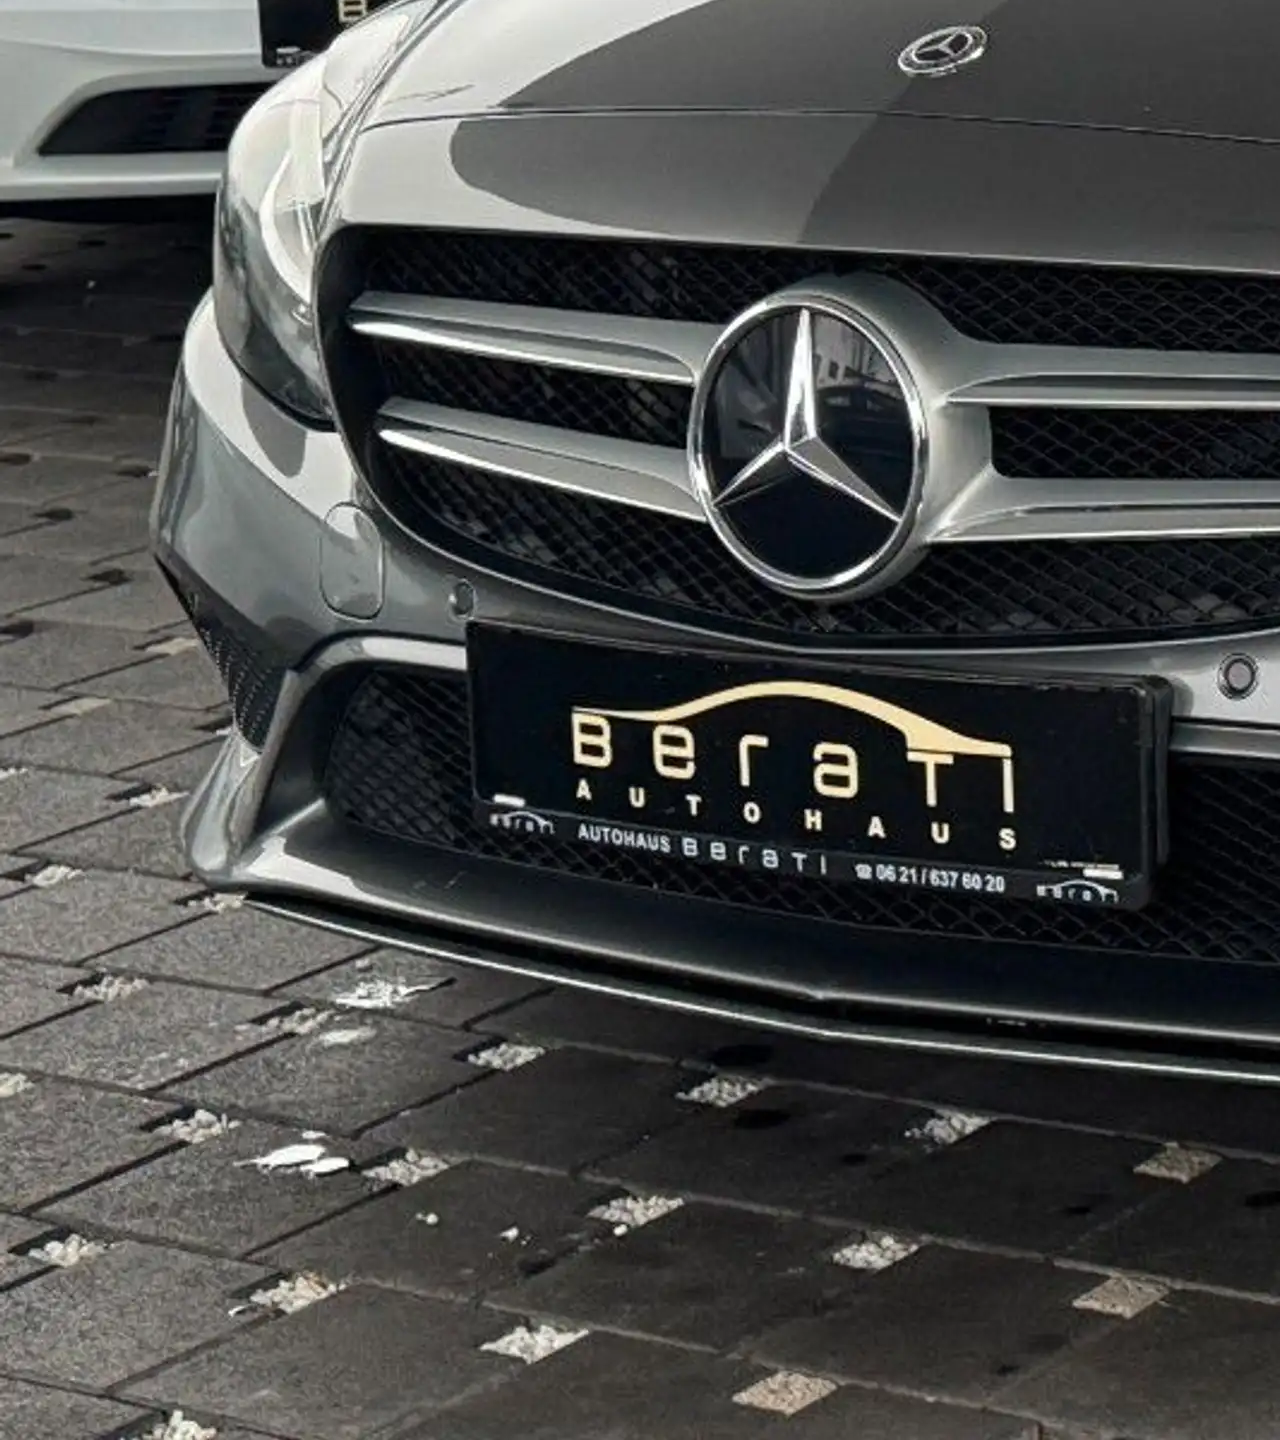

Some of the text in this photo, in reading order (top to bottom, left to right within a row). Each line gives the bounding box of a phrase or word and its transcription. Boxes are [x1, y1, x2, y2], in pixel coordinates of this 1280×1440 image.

[576, 777, 1017, 850] AUTOHAUS
[577, 822, 672, 853] AUTOHAUS
[875, 863, 897, 882] 06
[898, 865, 918, 885] 21
[929, 868, 960, 889] 637
[984, 873, 1006, 893] 20
